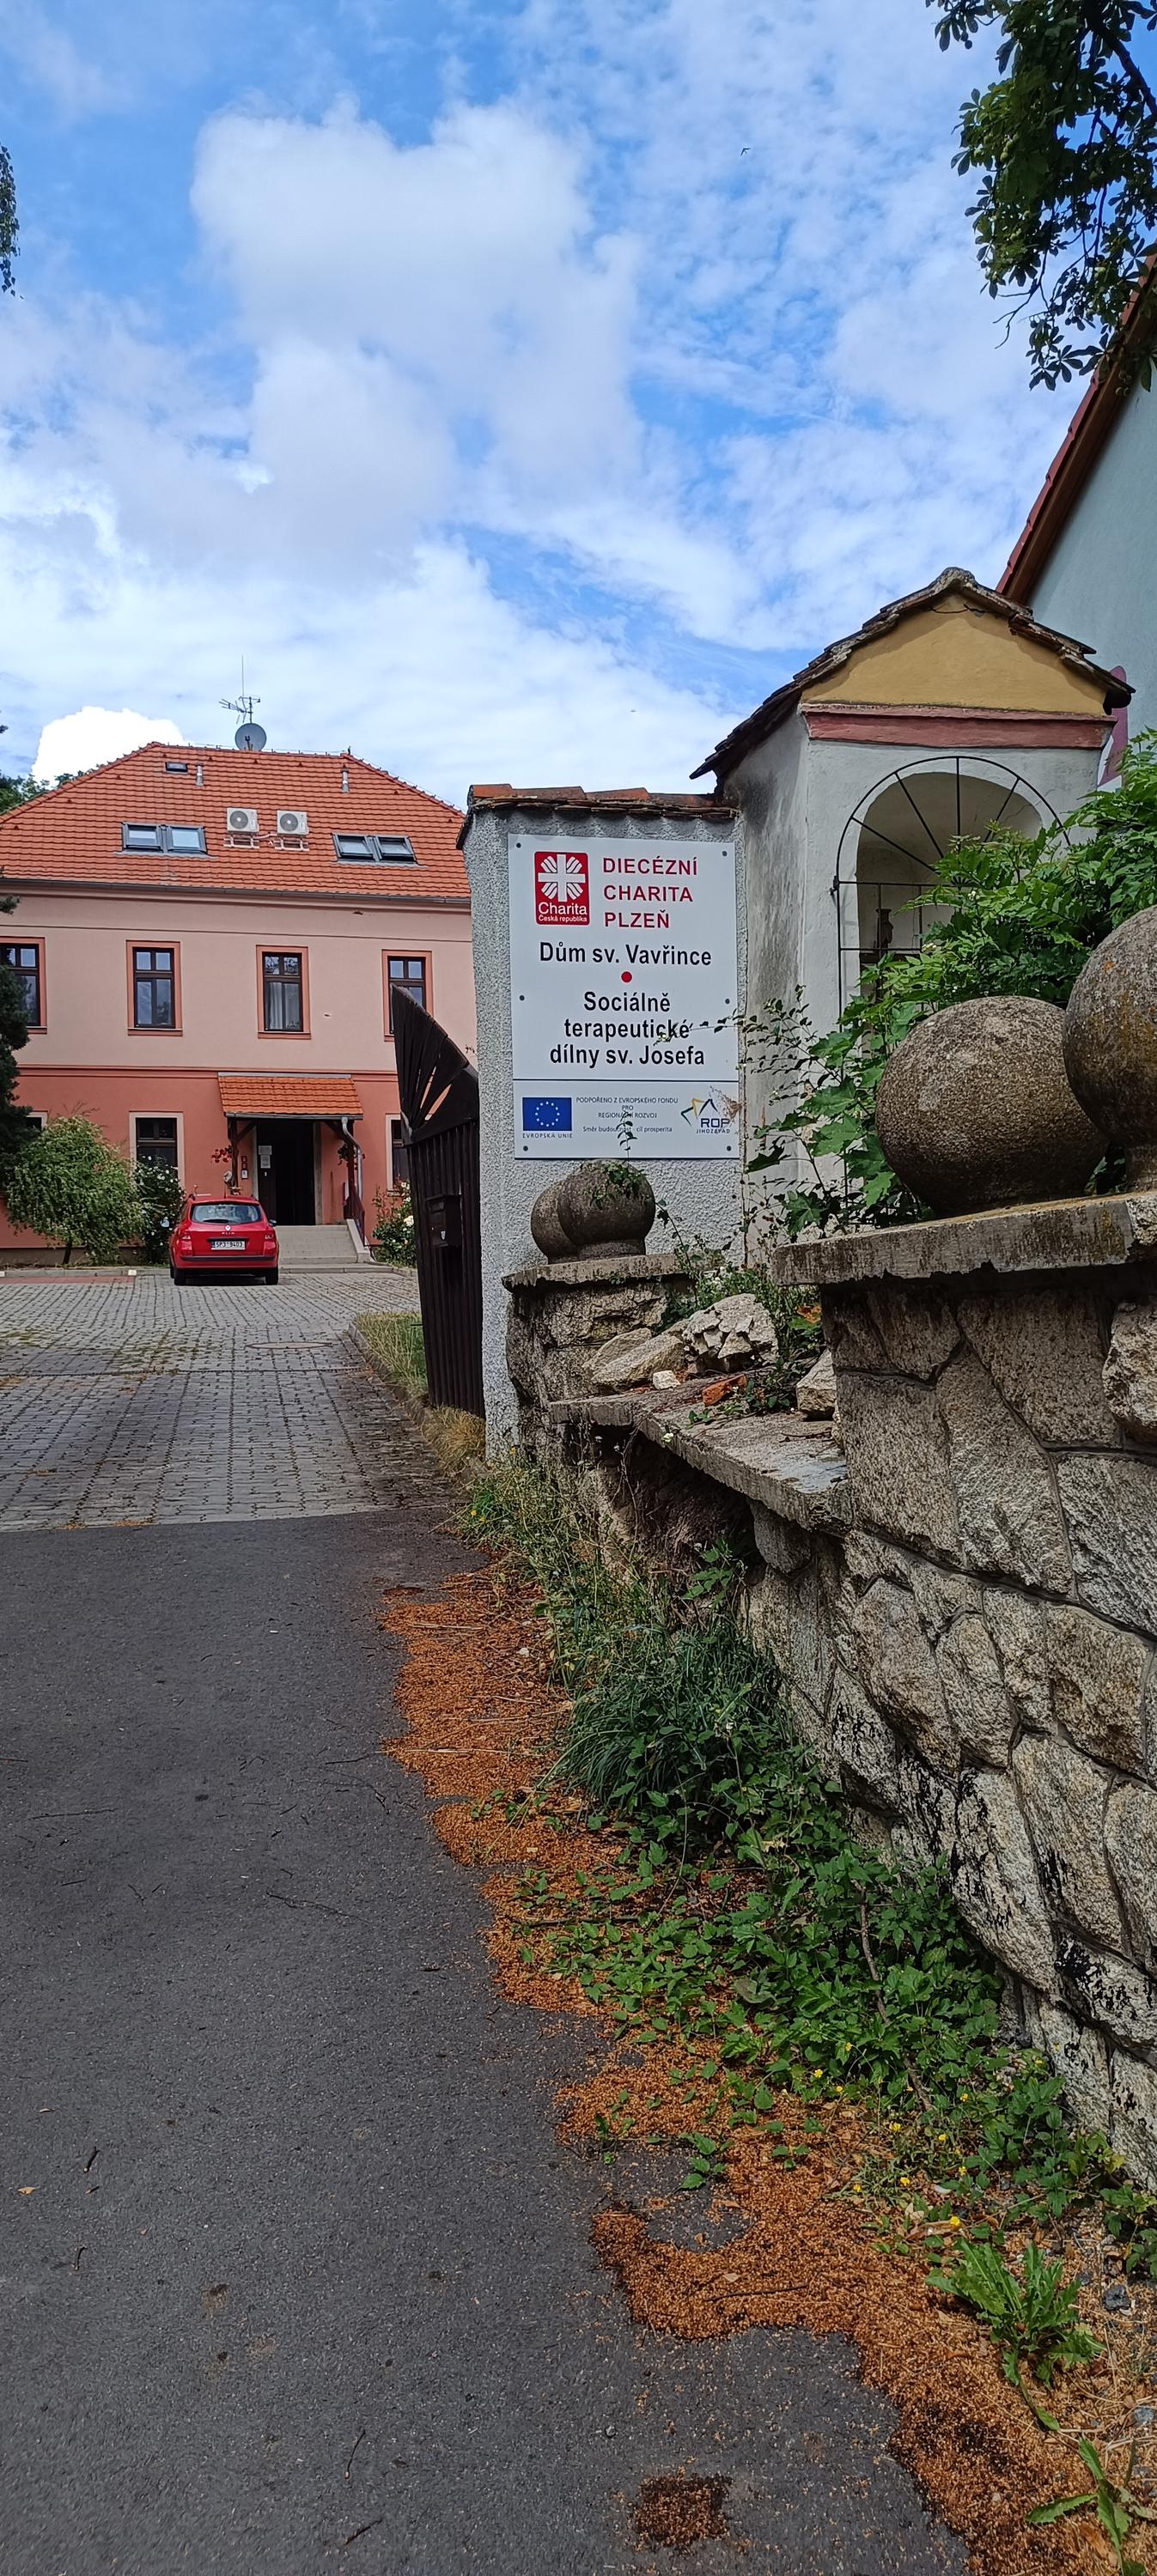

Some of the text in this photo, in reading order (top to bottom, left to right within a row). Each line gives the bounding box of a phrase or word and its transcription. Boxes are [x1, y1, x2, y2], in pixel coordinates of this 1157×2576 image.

[603, 855, 697, 875] DIECÉZNÍ
[604, 885, 693, 902] CHARITA
[538, 902, 588, 915] Charita
[604, 909, 670, 928] PLZEŇ
[539, 941, 712, 966] Dům sv. Vavřince
[584, 991, 671, 1012] Sociálně
[564, 1018, 690, 1042] terapeutické
[550, 1043, 705, 1069] dílny sv. Josefa
[700, 1118, 730, 1128] ROP
